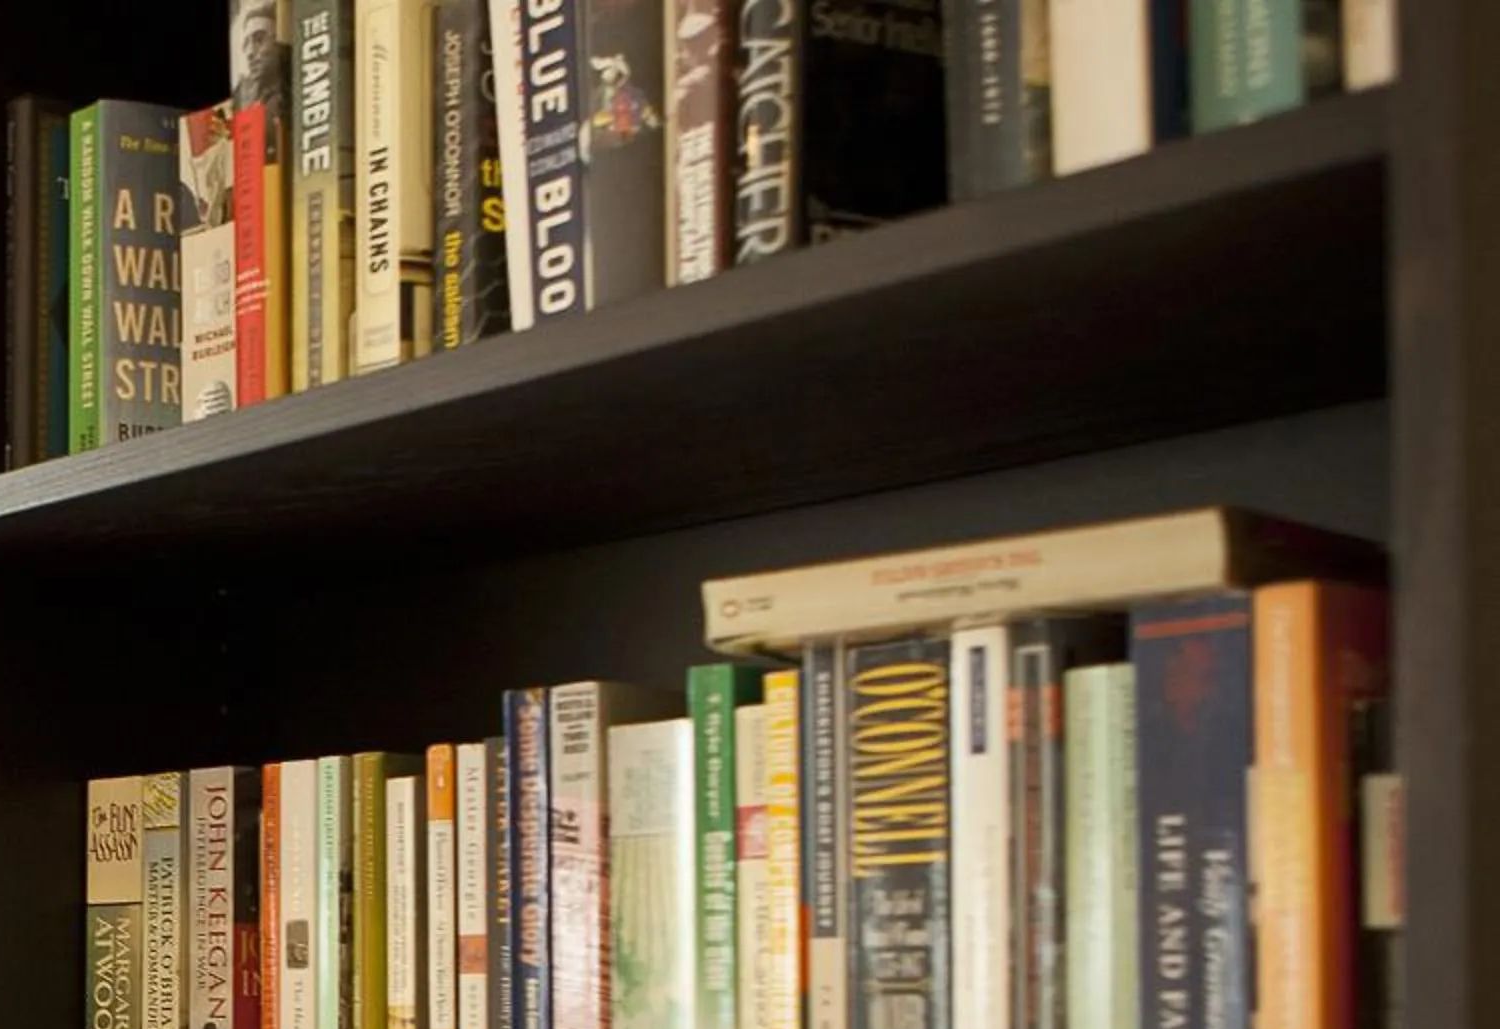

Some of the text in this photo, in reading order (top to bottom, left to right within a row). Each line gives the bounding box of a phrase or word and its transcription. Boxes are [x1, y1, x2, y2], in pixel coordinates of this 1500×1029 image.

[302, 10, 331, 177] THE GAMBLE
[736, 0, 792, 265] CATCHER
[80, 135, 95, 201] RANDOM
[367, 146, 390, 174] IN
[444, 29, 462, 267] JOSEPH O'CONNOR the
[80, 207, 95, 251] WALK
[113, 188, 137, 231] A
[367, 182, 390, 275] CHAINS
[534, 174, 577, 315] BLOO
[80, 253, 95, 301] DOWN
[113, 245, 181, 291] WAL
[80, 305, 95, 347] WALL
[113, 302, 181, 349] WAL
[80, 352, 95, 409] STREET
[114, 358, 181, 405] STR
[854, 661, 945, 879] O'CONNELL
[519, 704, 546, 967] Some Desperate Glory
[1155, 812, 1190, 892] LIFE
[147, 861, 159, 922] MASTER
[160, 857, 176, 946] PATRICK
[196, 817, 207, 991] INTELLIGENCE IN WAR
[207, 785, 229, 1021] JOHN KEEGAN
[1155, 903, 1190, 981] AND
